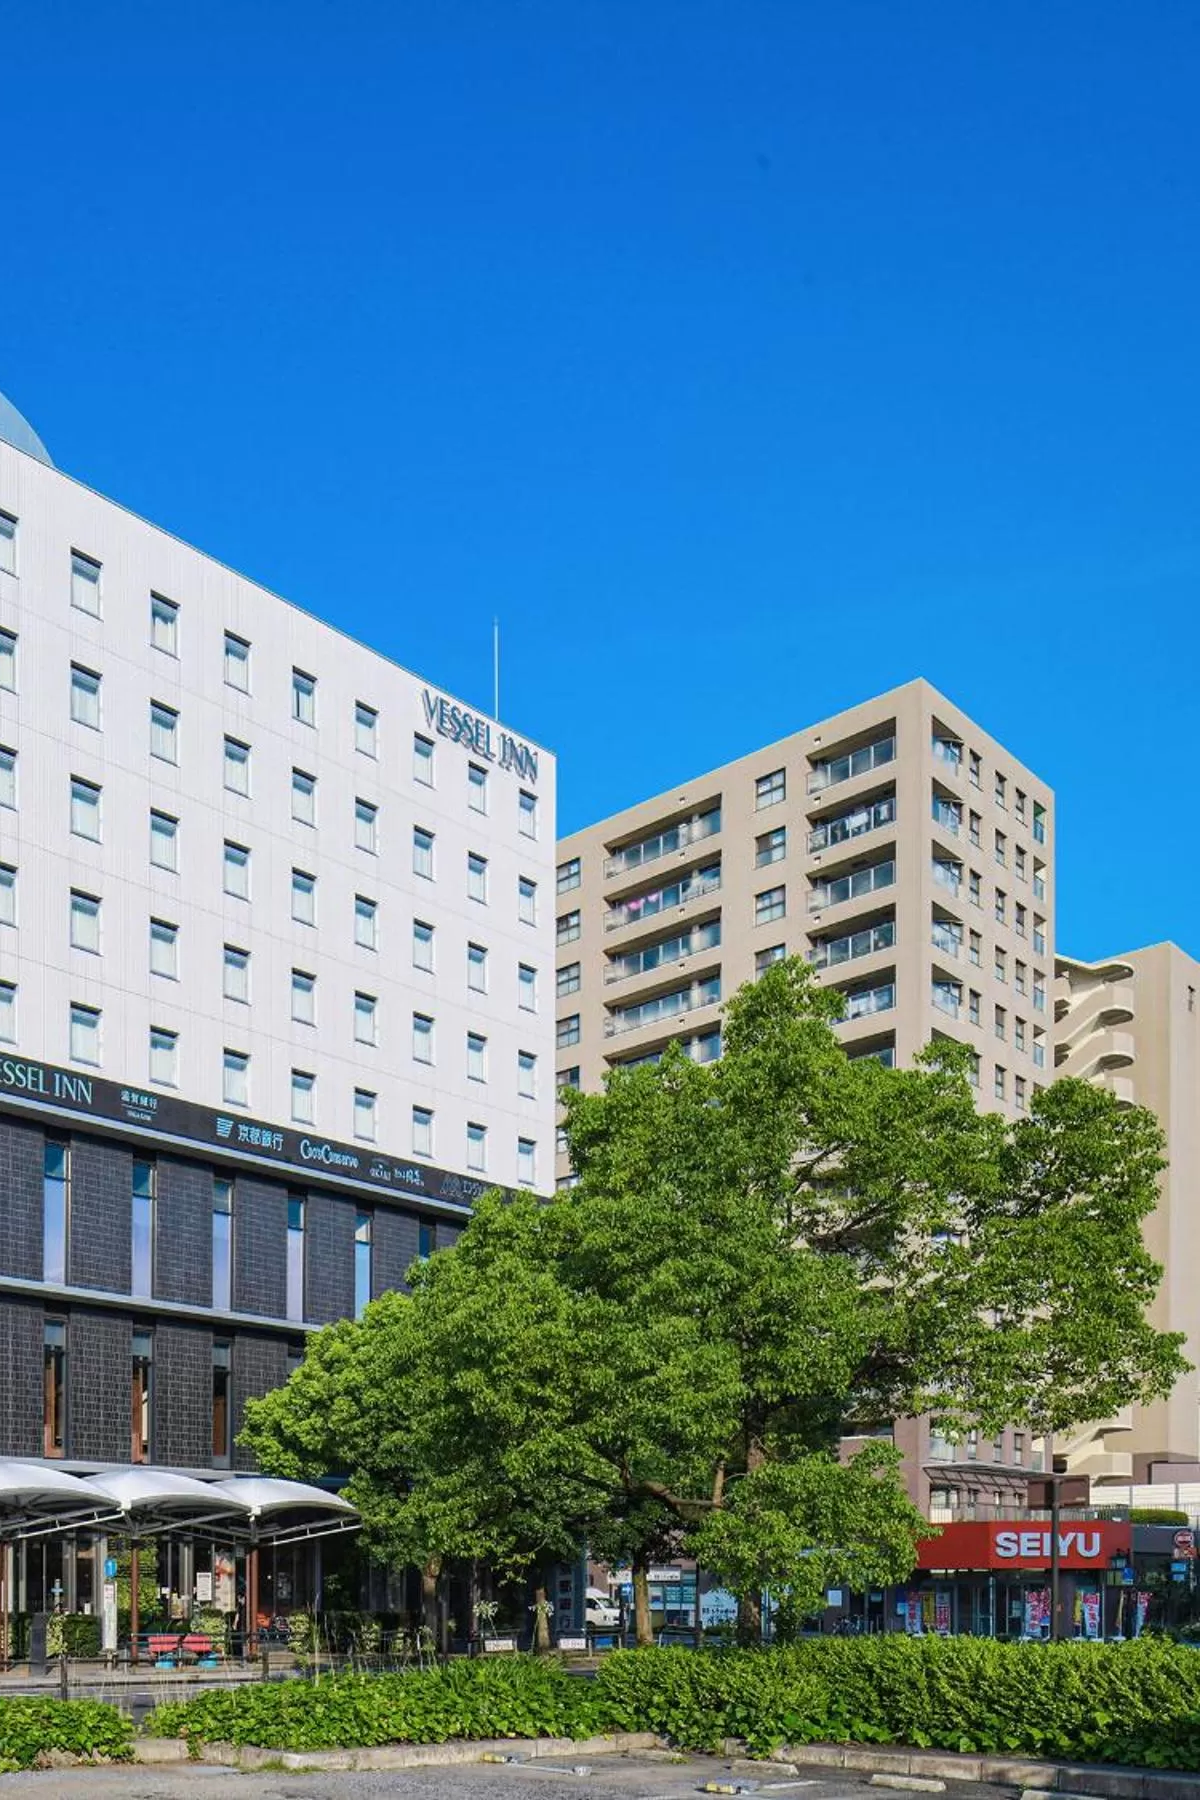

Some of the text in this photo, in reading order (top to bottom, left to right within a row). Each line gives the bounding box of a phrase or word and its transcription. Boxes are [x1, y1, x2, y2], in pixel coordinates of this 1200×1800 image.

[421, 688, 538, 785] VESSEL INN
[54, 1072, 93, 1105] INN
[237, 1123, 284, 1152] 京都銀行
[995, 1532, 1100, 1558] SEIYU
